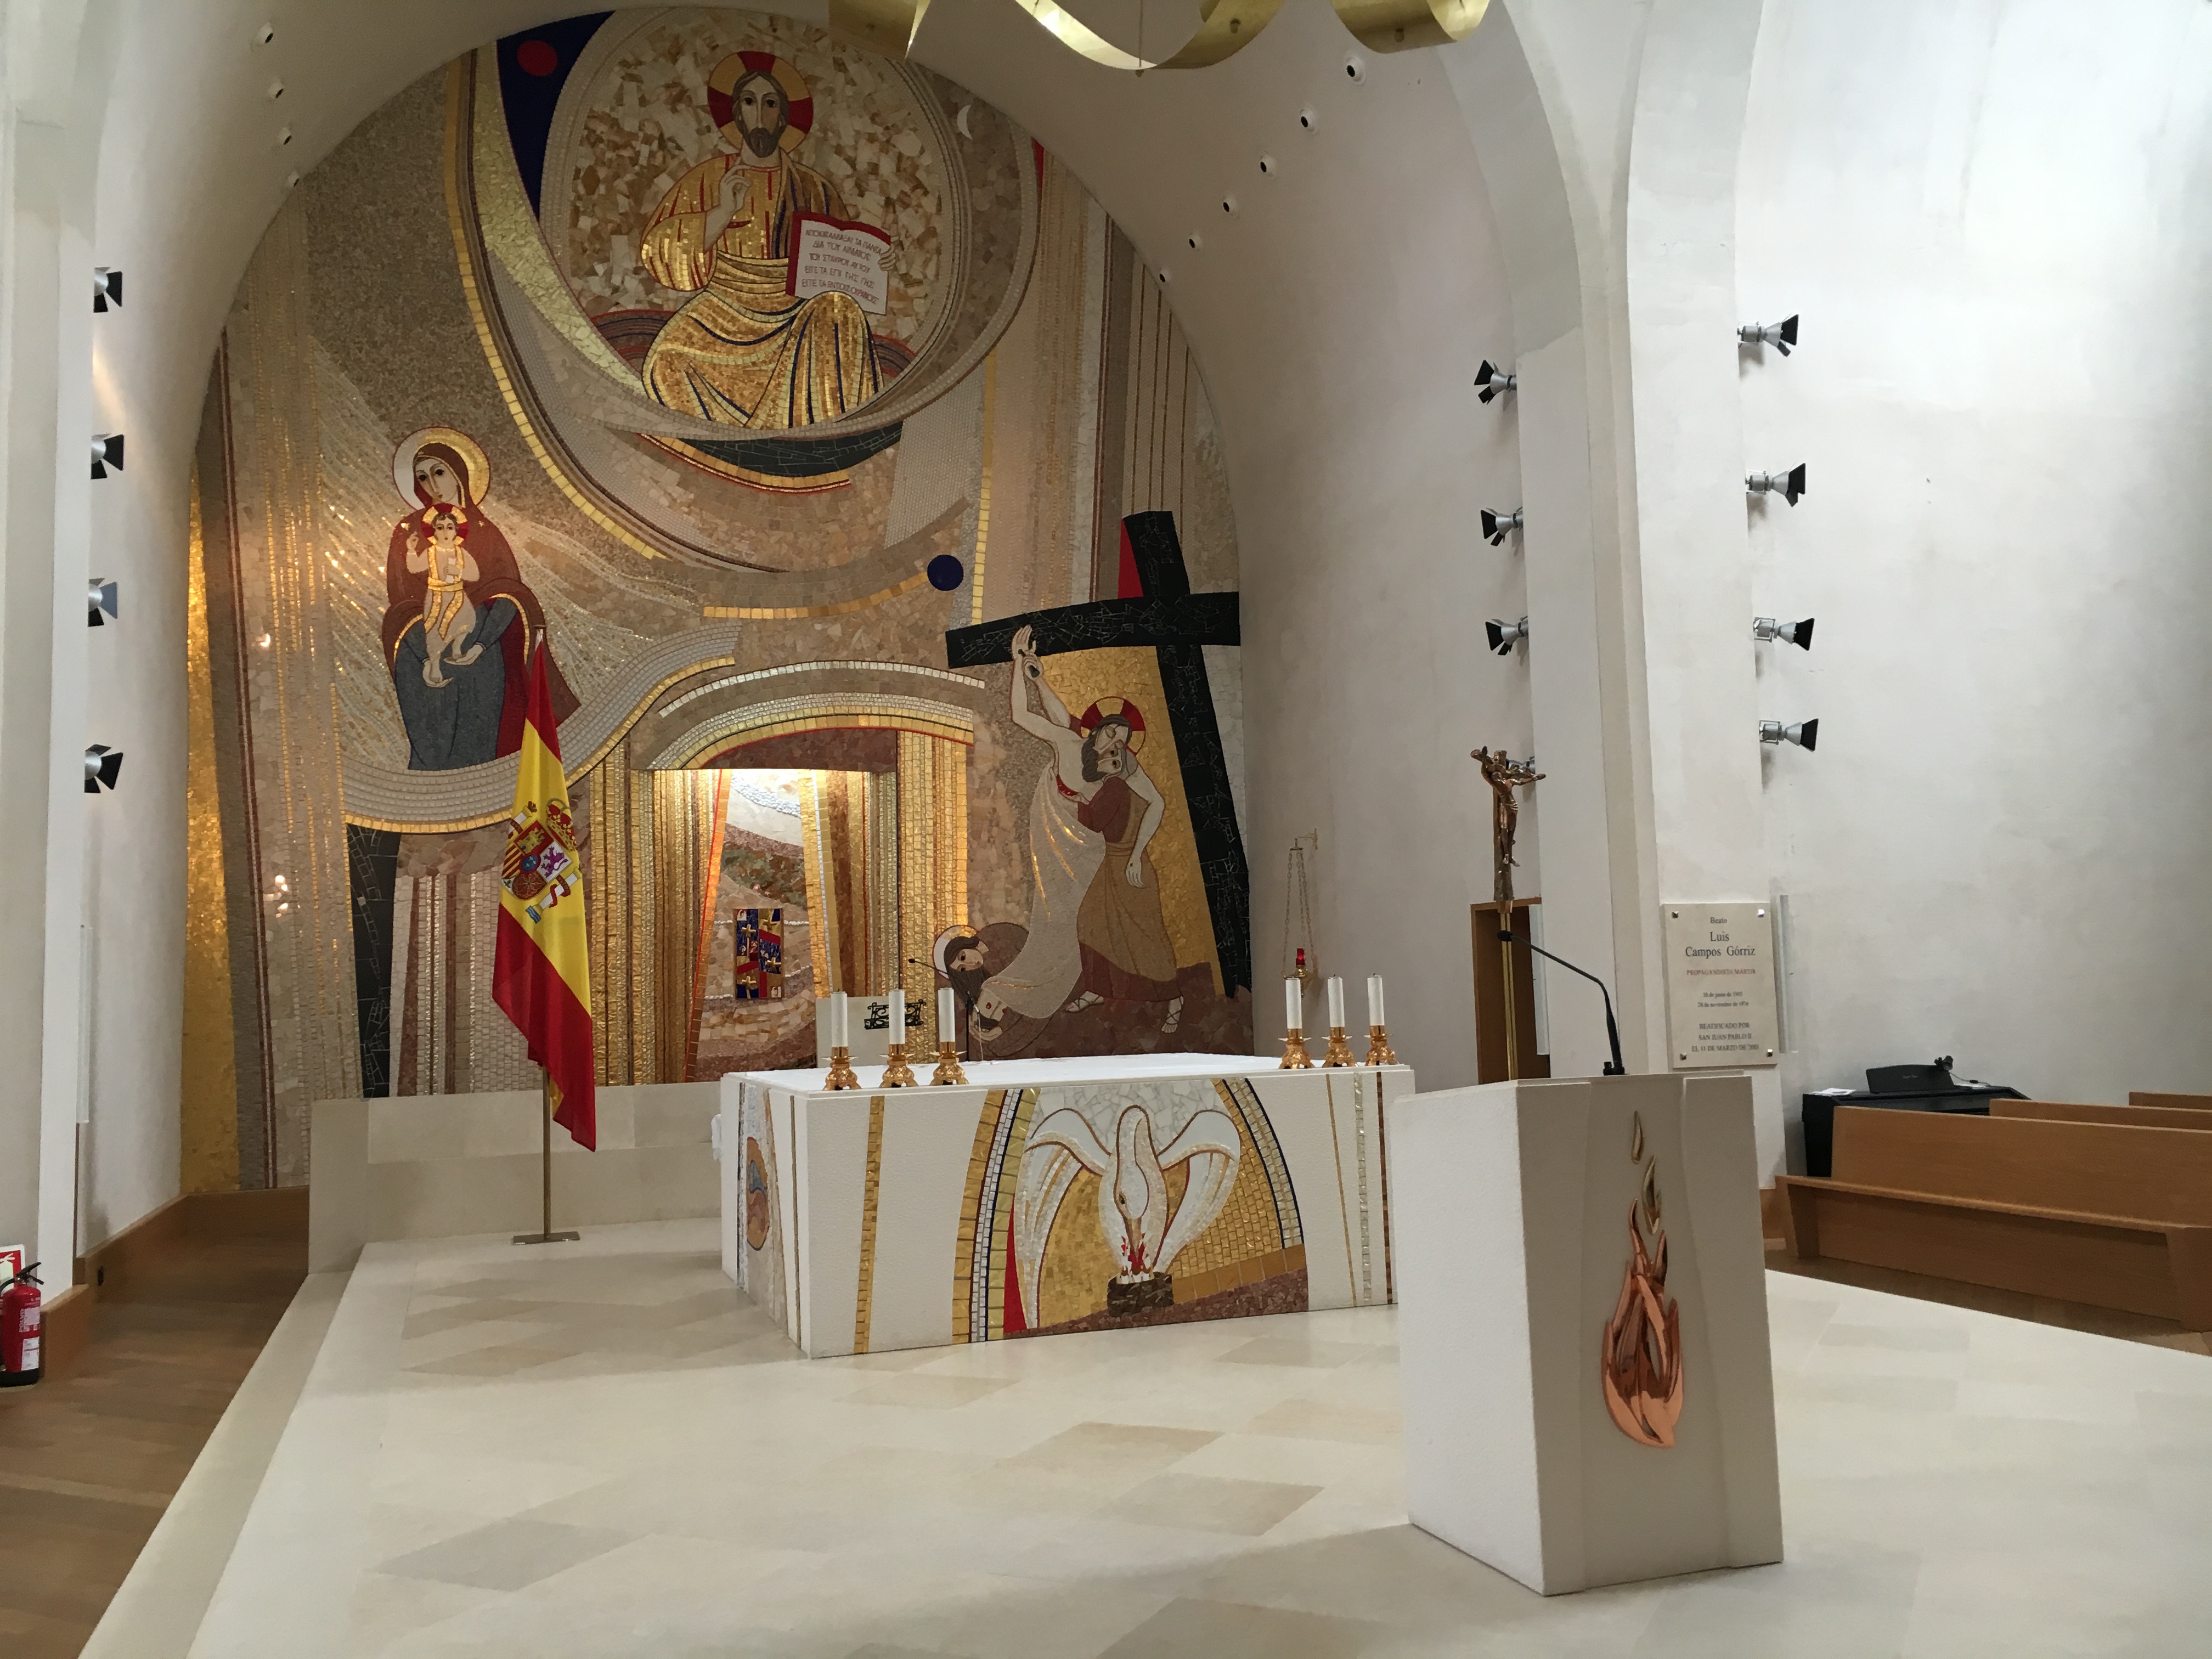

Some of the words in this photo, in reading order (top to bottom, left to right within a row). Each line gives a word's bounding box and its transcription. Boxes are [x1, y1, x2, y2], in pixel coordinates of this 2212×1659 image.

[827, 241, 840, 251] ΤΟΥ
[1710, 931, 1730, 941] Luis
[1685, 946, 1722, 959] Campos
[1726, 945, 1756, 956] Górriz
